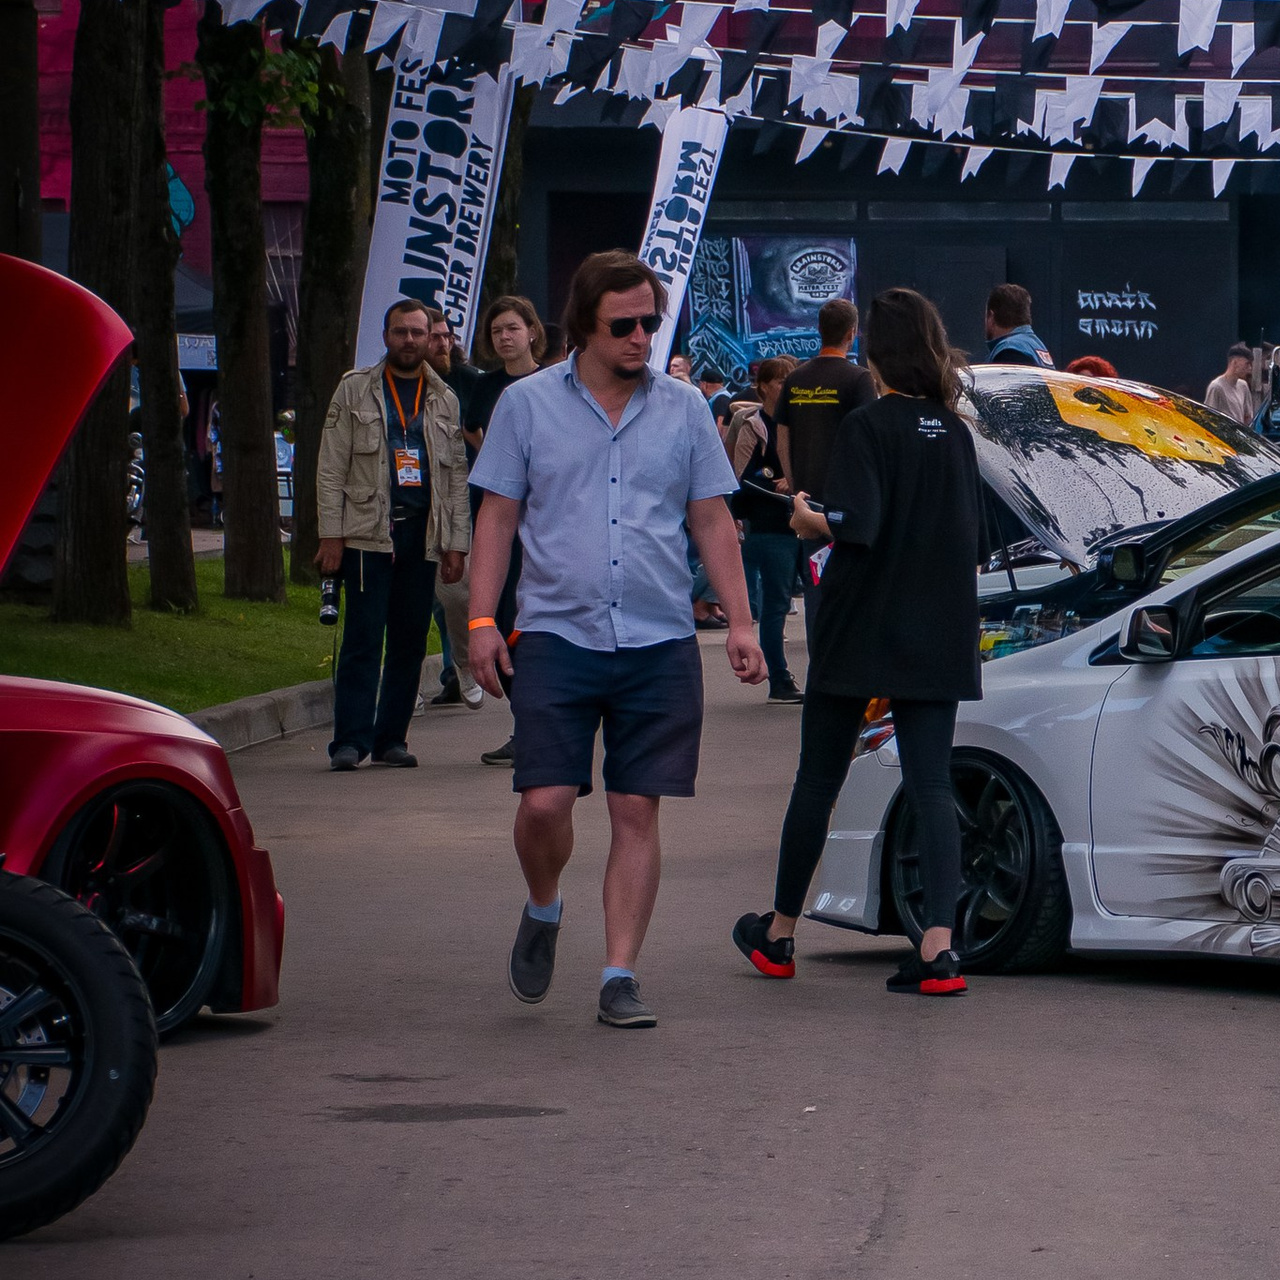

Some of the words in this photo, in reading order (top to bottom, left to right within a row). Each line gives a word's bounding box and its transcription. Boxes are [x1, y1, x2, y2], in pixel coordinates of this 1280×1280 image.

[394, 57, 429, 112] FES
[381, 119, 420, 205] MOTO
[398, 79, 476, 315] AINSTOR
[454, 132, 493, 258] BREWERY
[443, 259, 474, 341] CHER
